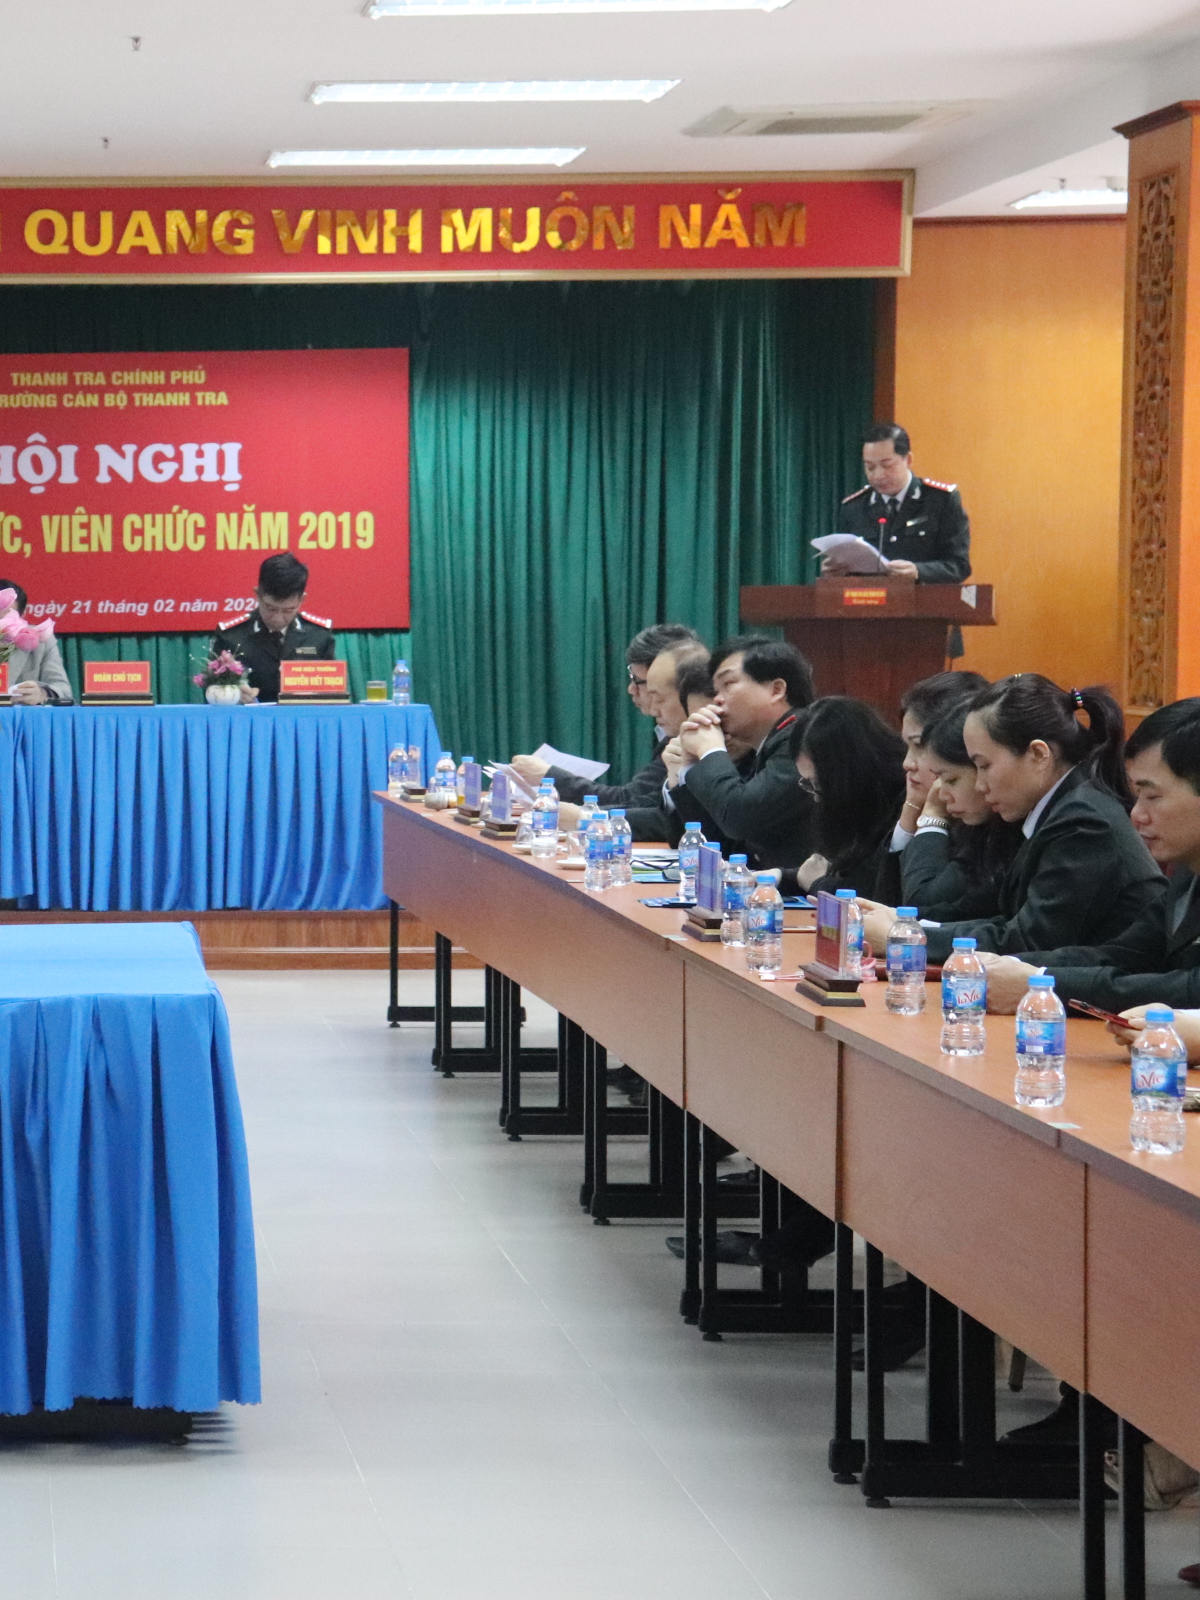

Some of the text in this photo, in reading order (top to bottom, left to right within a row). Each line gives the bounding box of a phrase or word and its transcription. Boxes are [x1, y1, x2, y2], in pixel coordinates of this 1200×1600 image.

[23, 209, 255, 256] QUANG
[271, 208, 422, 254] VINH
[440, 191, 636, 253] MUÔN
[658, 188, 807, 249] NĂM
[10, 365, 206, 386] THANH TRA CHÍNH PHỦ
[62, 390, 99, 407] CÁN
[104, 389, 128, 410] BỘ
[133, 392, 191, 407] THANH
[195, 391, 229, 406] TRA
[94, 442, 243, 492] NGHỊ
[41, 506, 113, 553] VIÊN
[122, 505, 206, 552] CHỨC
[216, 504, 289, 550] NĂM
[298, 511, 375, 549] 2019
[26, 600, 67, 617] ngày
[71, 600, 92, 613] 21
[97, 599, 147, 616] tháng
[153, 599, 175, 613] 02
[179, 598, 218, 613] năm
[1136, 1071, 1164, 1090] laVie
